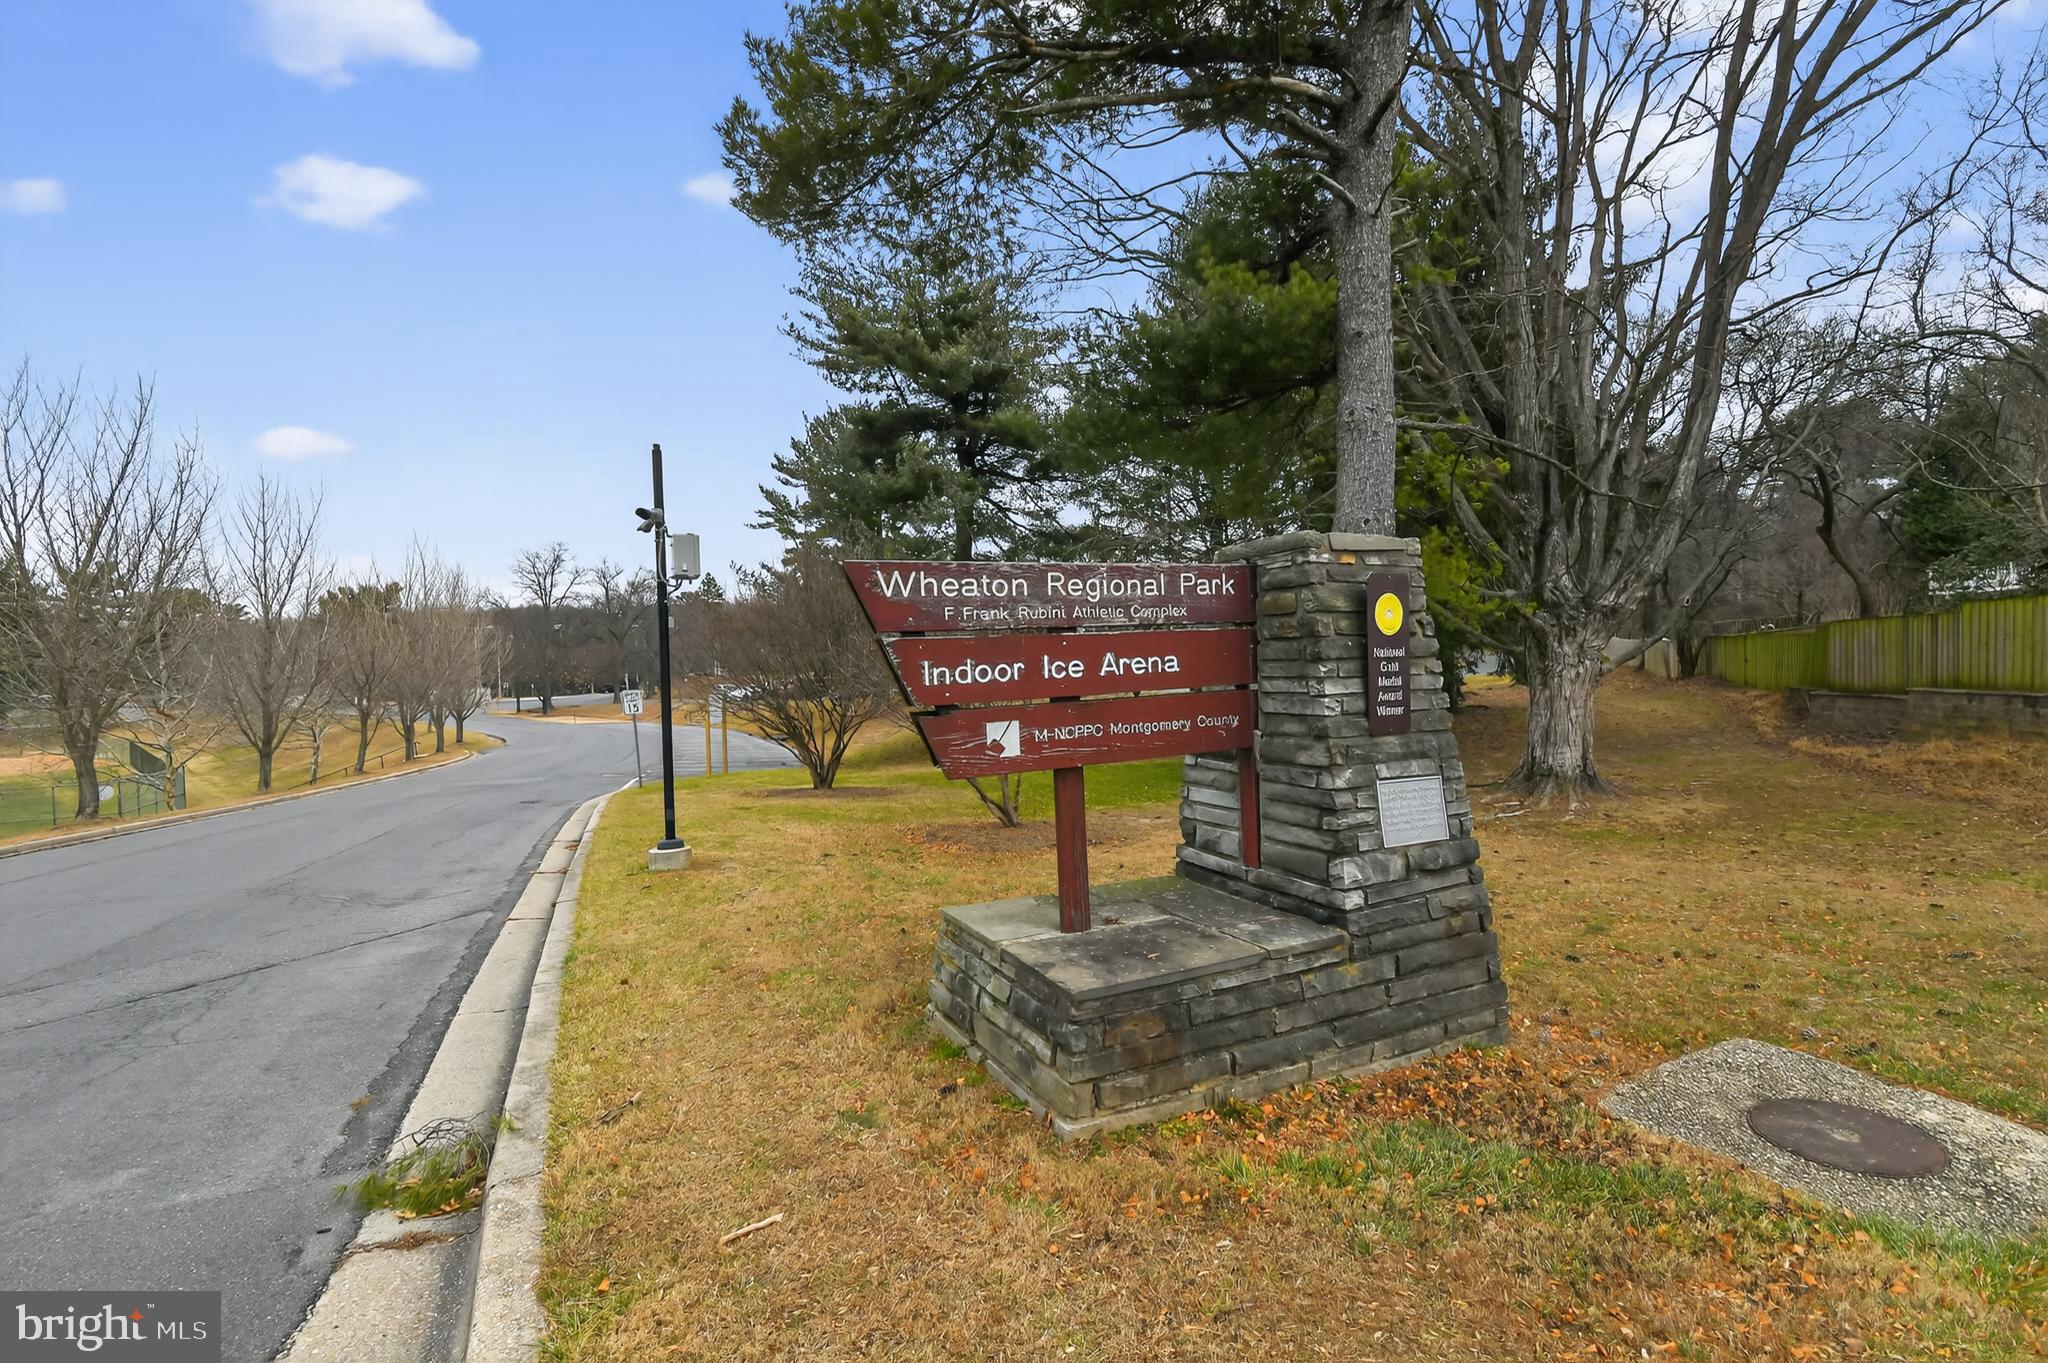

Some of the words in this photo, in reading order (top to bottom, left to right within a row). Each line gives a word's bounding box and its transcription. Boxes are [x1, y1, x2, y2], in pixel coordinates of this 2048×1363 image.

[876, 570, 1028, 598] Wheaton
[1047, 572, 1165, 603] Regional
[1180, 573, 1235, 596] Park
[1018, 605, 1066, 620] Rubini
[1073, 605, 1124, 619] Athletic
[1130, 604, 1187, 620] Complex
[923, 659, 1025, 686] Indoor
[1043, 654, 1084, 679] Ice
[1099, 652, 1180, 676] Arena
[629, 703, 639, 713] 15
[1034, 723, 1104, 742] M-NCPPC
[1110, 719, 1191, 735] Montgomery
[1197, 714, 1239, 728] County
